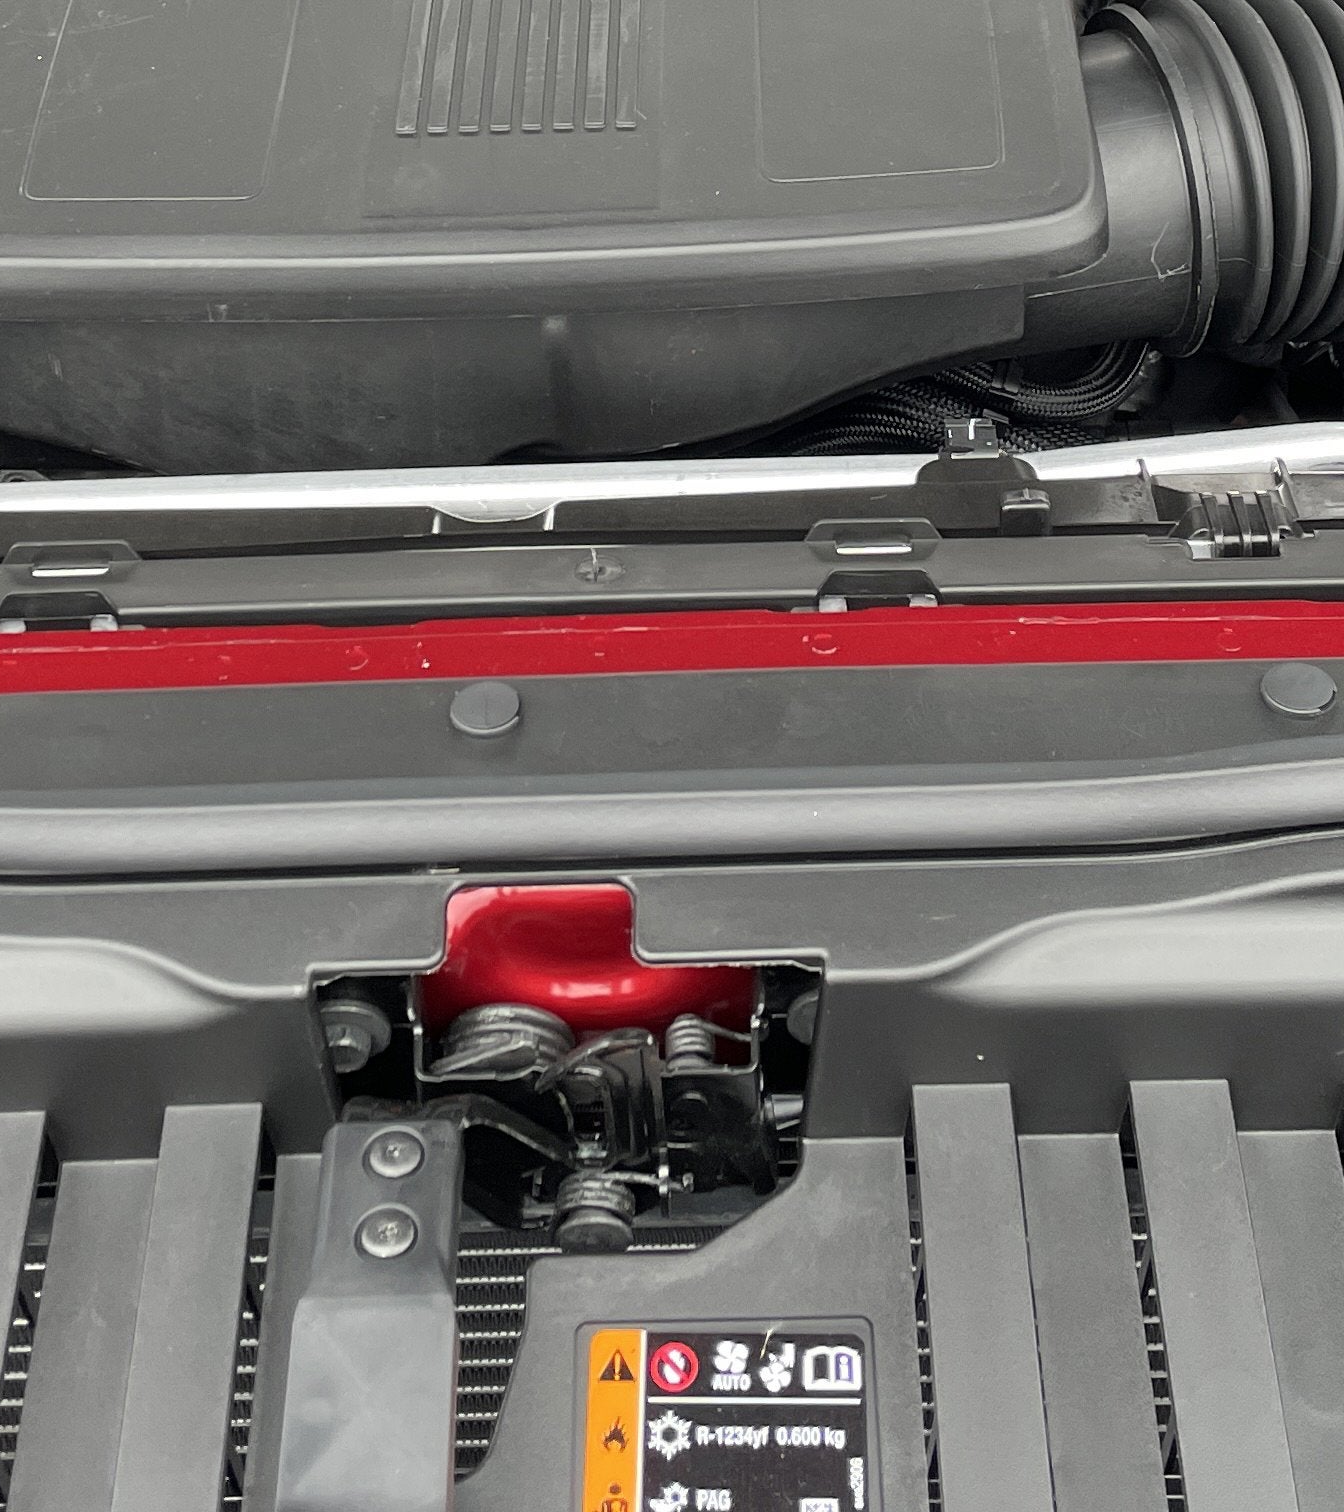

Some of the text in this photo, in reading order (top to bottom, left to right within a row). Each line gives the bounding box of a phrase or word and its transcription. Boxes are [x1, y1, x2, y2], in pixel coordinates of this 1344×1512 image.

[712, 1373, 751, 1391] AUTO
[696, 1425, 846, 1450] R-1234yf 0.600 kg
[696, 1488, 732, 1511] PAG
